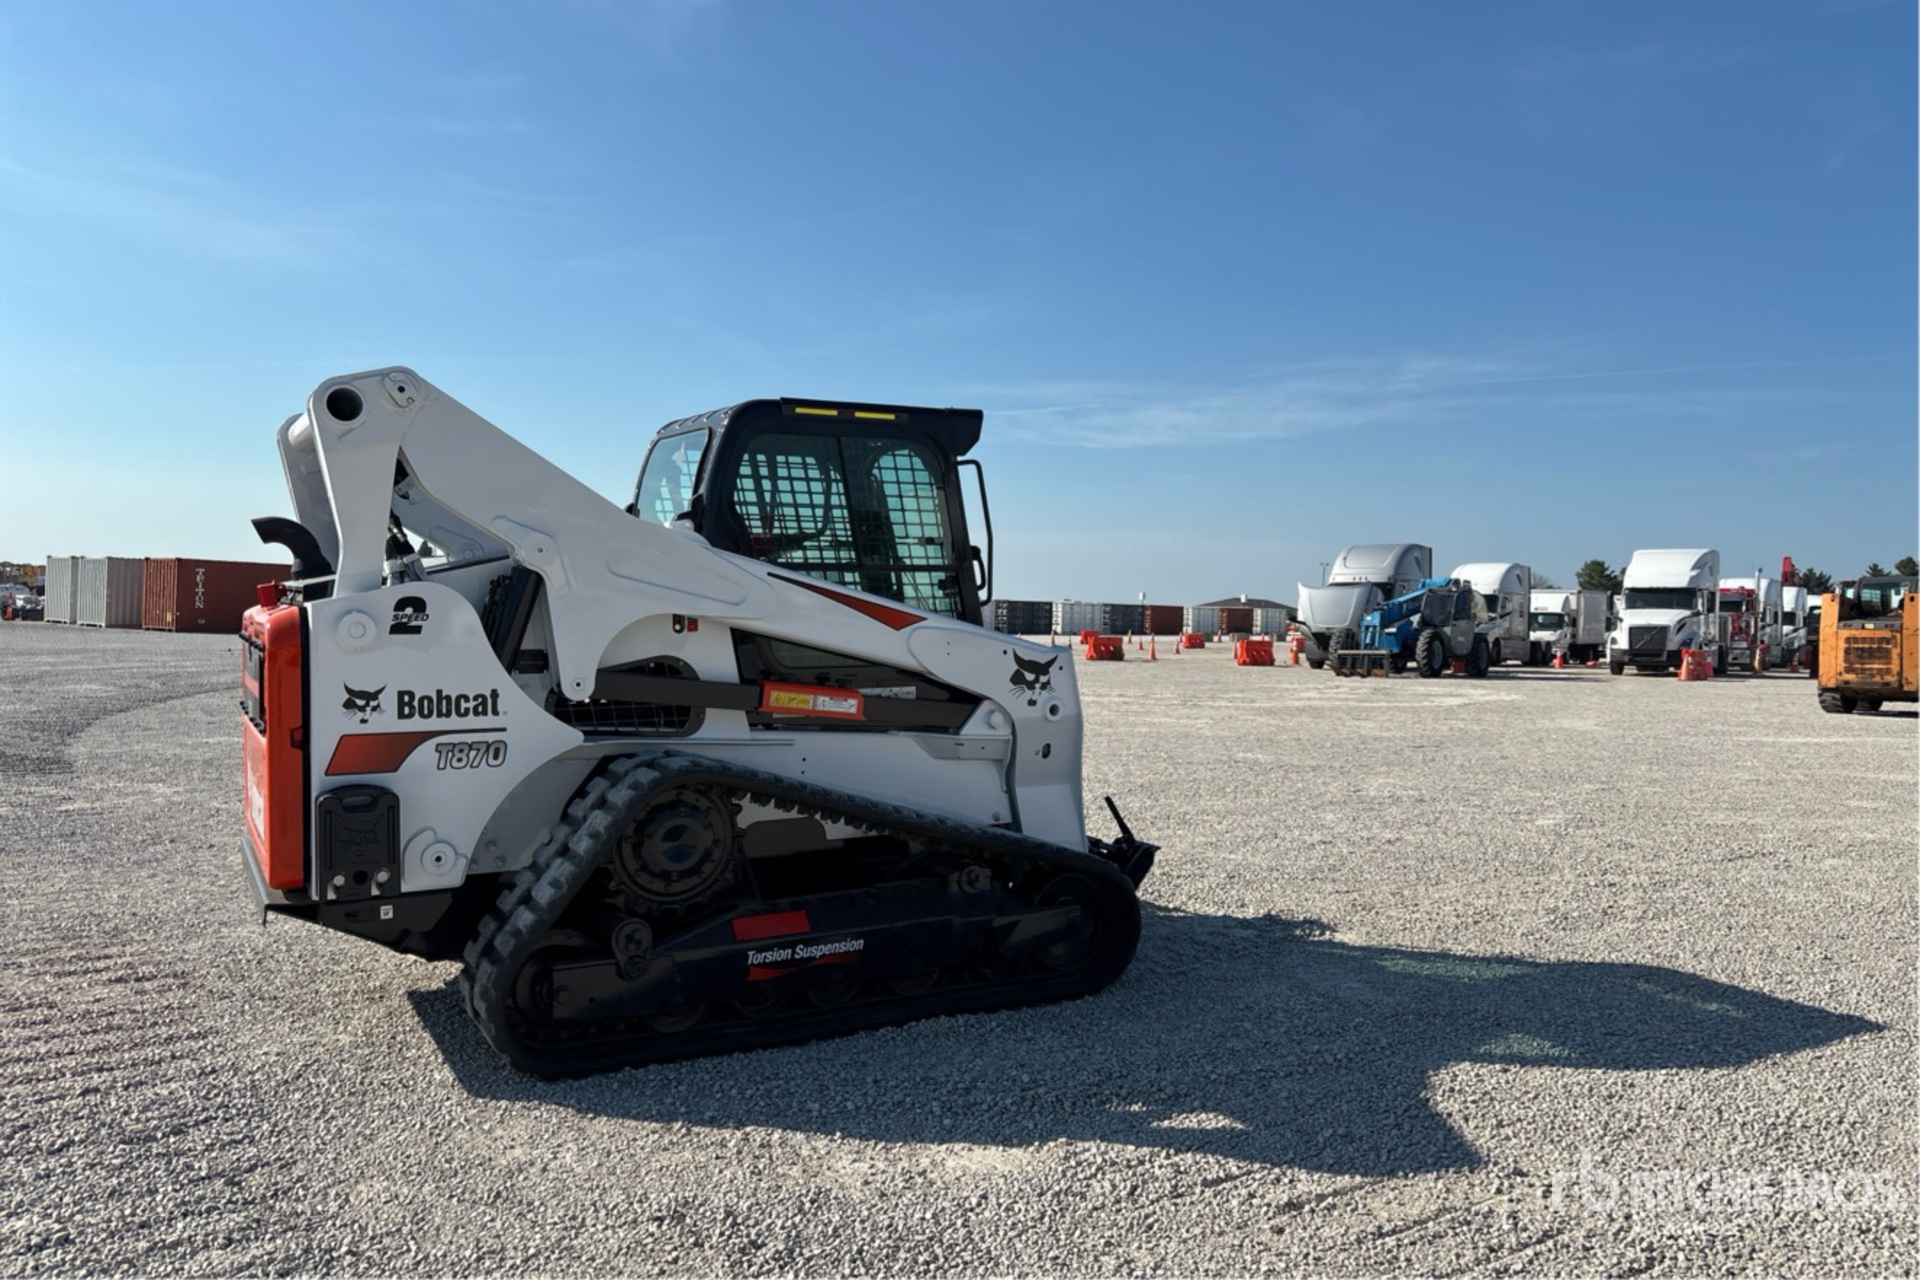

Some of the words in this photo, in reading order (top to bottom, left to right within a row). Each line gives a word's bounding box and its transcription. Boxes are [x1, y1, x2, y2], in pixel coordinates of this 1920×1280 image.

[388, 595, 427, 635] 2
[391, 613, 430, 622] SPEED
[397, 688, 500, 720] Bobcat
[434, 739, 508, 771] T870
[747, 947, 792, 965] Torsion
[794, 938, 865, 959] Suspension
